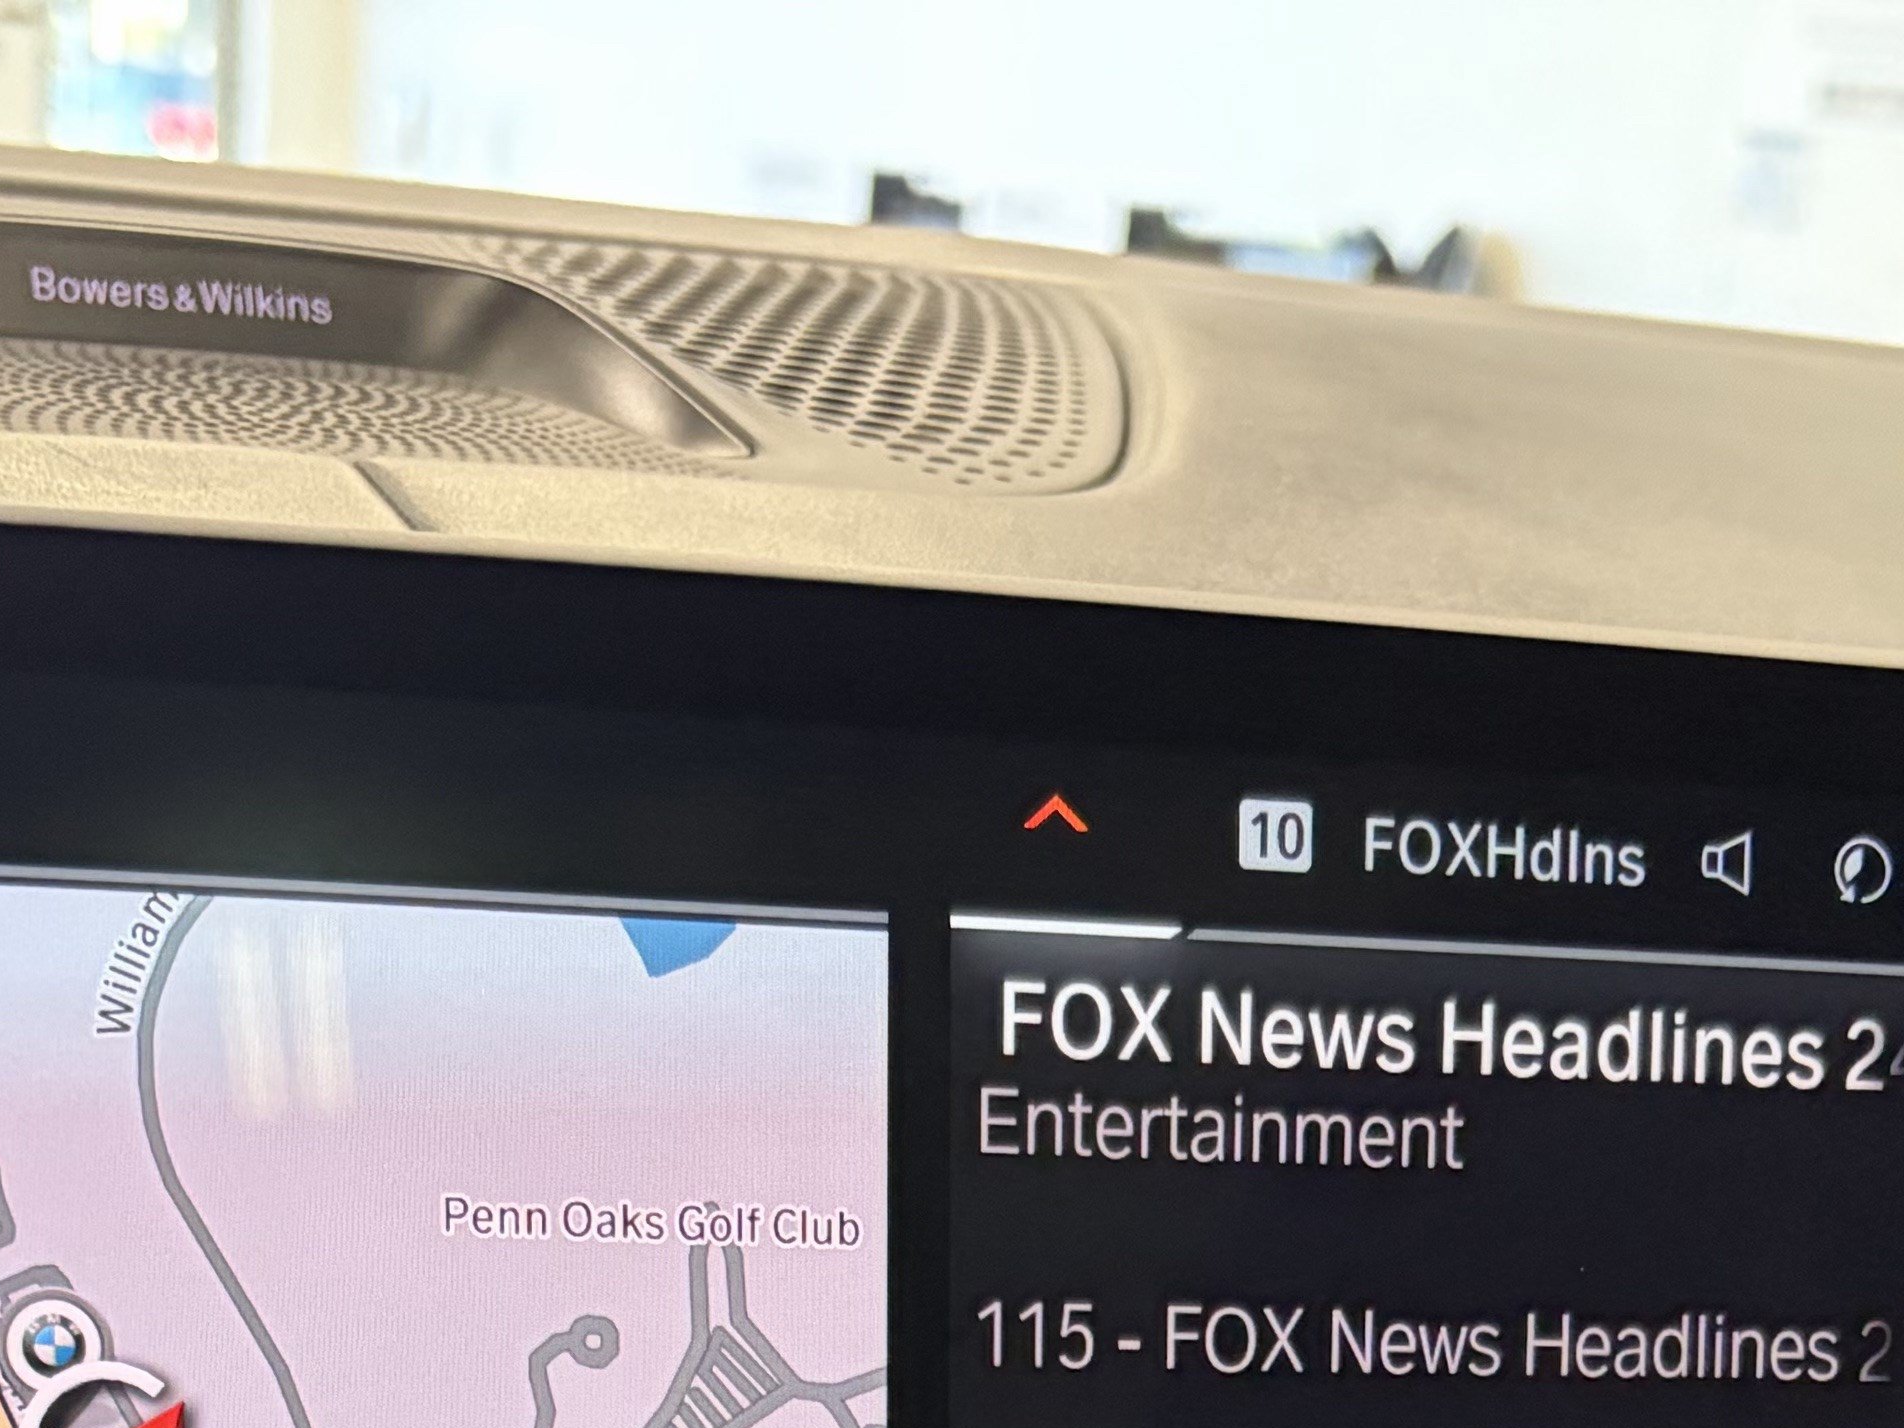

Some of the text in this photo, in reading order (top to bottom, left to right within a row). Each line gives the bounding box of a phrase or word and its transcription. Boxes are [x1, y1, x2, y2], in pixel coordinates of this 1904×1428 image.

[1251, 811, 1305, 860] 10
[1364, 816, 1646, 887] FOXHdlns
[1002, 979, 1172, 1062] FOX
[1200, 988, 1415, 1073] News
[1442, 1000, 1825, 1090] Headlines
[980, 1086, 1464, 1169] Entertainment
[445, 1197, 860, 1246] Penn Oaks Golf Club
[978, 1301, 1094, 1369] 115
[1166, 1304, 1304, 1373] FOX
[1331, 1308, 1501, 1377] News
[1525, 1312, 1839, 1382] Headlines
